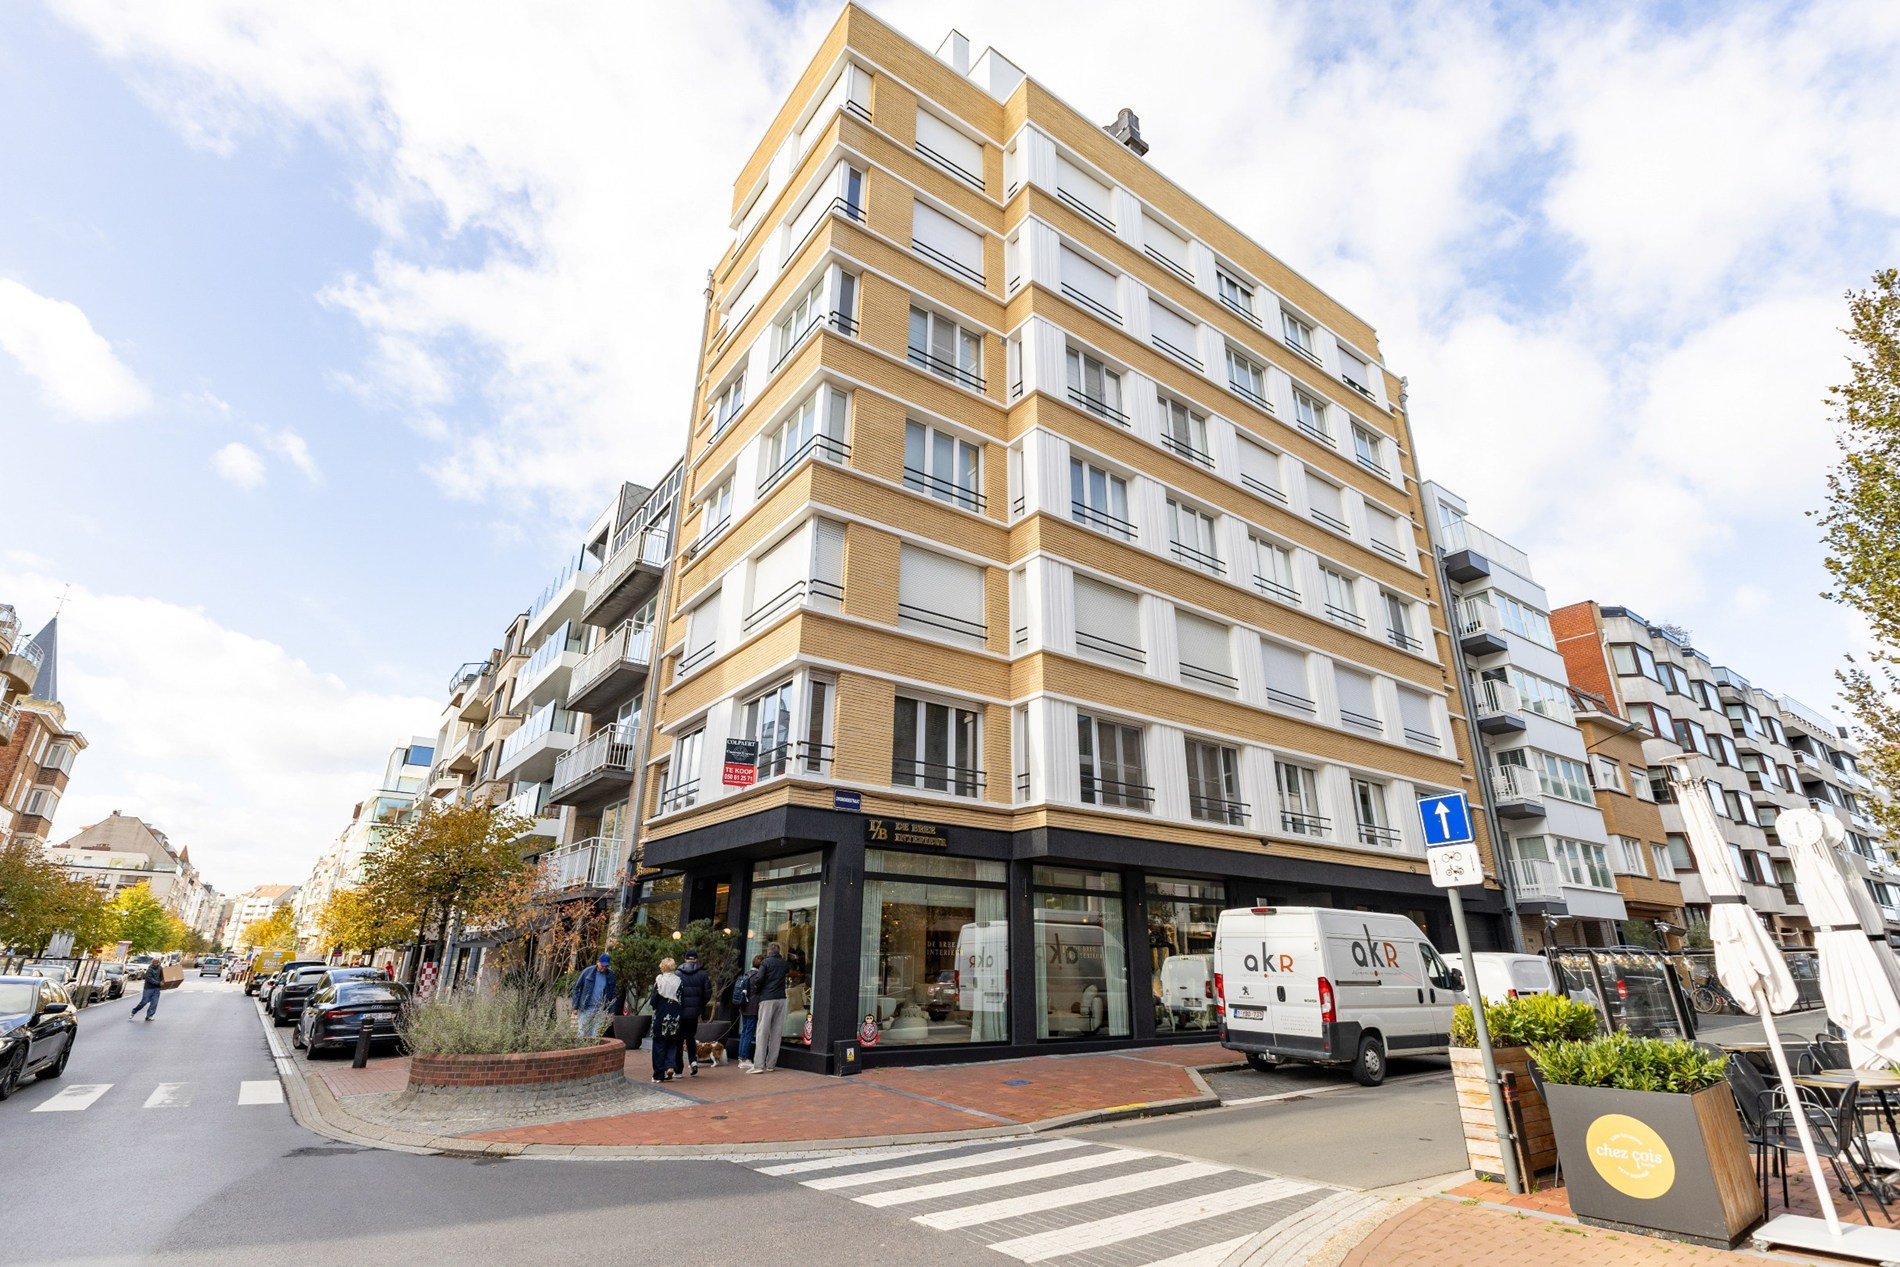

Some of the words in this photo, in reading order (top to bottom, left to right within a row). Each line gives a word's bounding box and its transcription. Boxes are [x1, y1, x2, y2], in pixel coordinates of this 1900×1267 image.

[895, 822, 909, 831] DE
[911, 824, 936, 835] BREE
[895, 833, 947, 847] INTERIEUR
[1596, 1143, 1629, 1159] chez
